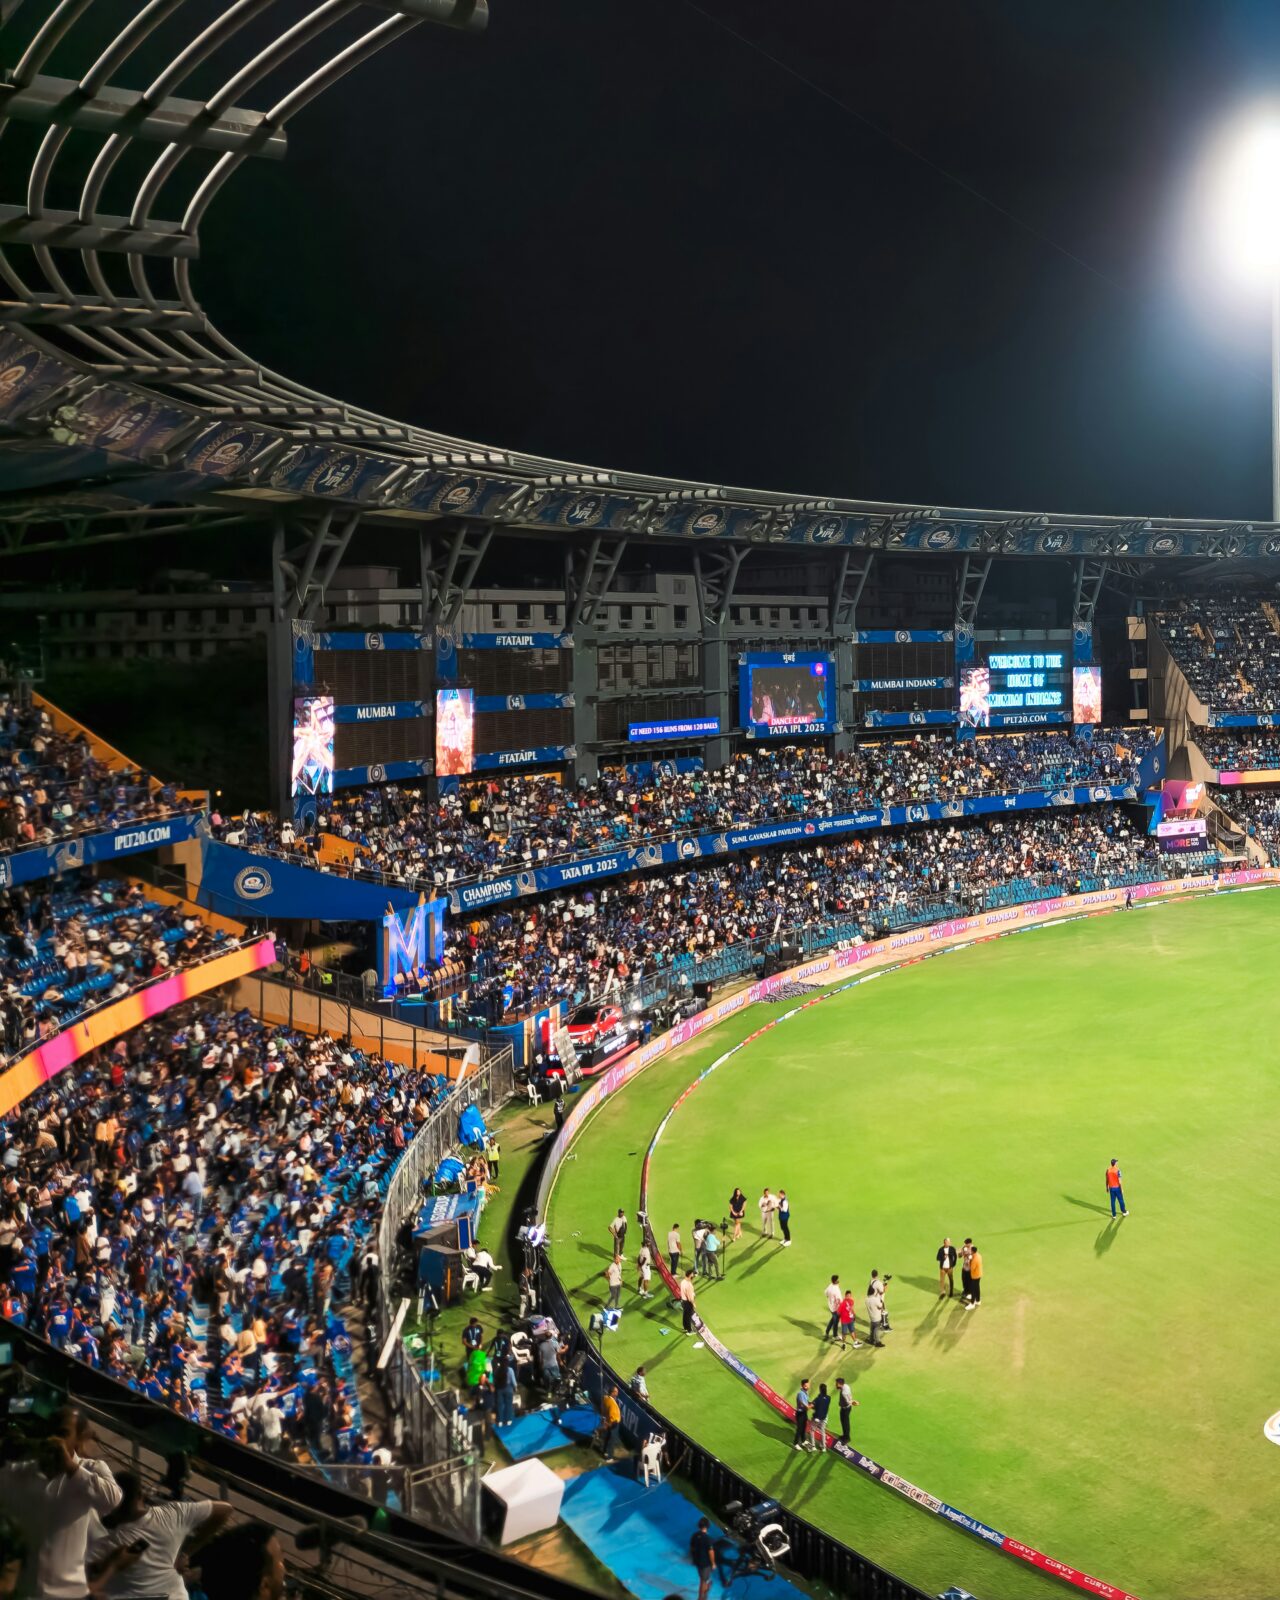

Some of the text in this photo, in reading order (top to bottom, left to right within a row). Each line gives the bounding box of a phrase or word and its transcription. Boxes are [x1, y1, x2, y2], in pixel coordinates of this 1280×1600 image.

[496, 635, 534, 646] #TATAIPL
[782, 654, 796, 663] मुंबई
[989, 655, 1031, 669] WELCOME
[871, 679, 937, 689] MUMBAI INDIANS
[357, 706, 396, 719] MUMBAI
[1003, 714, 1047, 724] IPLT20.COM
[771, 716, 808, 726] DANCE CAM
[638, 726, 652, 735] NEED
[703, 722, 718, 731] BALLS
[768, 723, 825, 735] TATA IPL 2025
[499, 751, 538, 764] #TATAIPL
[115, 826, 170, 850] IPLT20.COM
[731, 835, 747, 844] SUNIL
[778, 826, 802, 836] PAVILION
[1166, 838, 1191, 849] MORE
[560, 858, 618, 880] TATA IPL 2025
[463, 879, 512, 901] CHAMPIONS
[1082, 893, 1117, 905] DHANBAD
[985, 911, 1018, 925] DHANBAD
[1024, 908, 1038, 917] MAY
[890, 933, 925, 949] DHANBAD
[930, 931, 943, 940] MAY
[836, 957, 850, 968] MAY
[797, 961, 830, 980] DHANBAD
[859, 1456, 878, 1474] RuPay
[1009, 1540, 1036, 1557] CURVV
[1045, 1559, 1074, 1575] CURVV
[1084, 1576, 1114, 1593] CURVV
